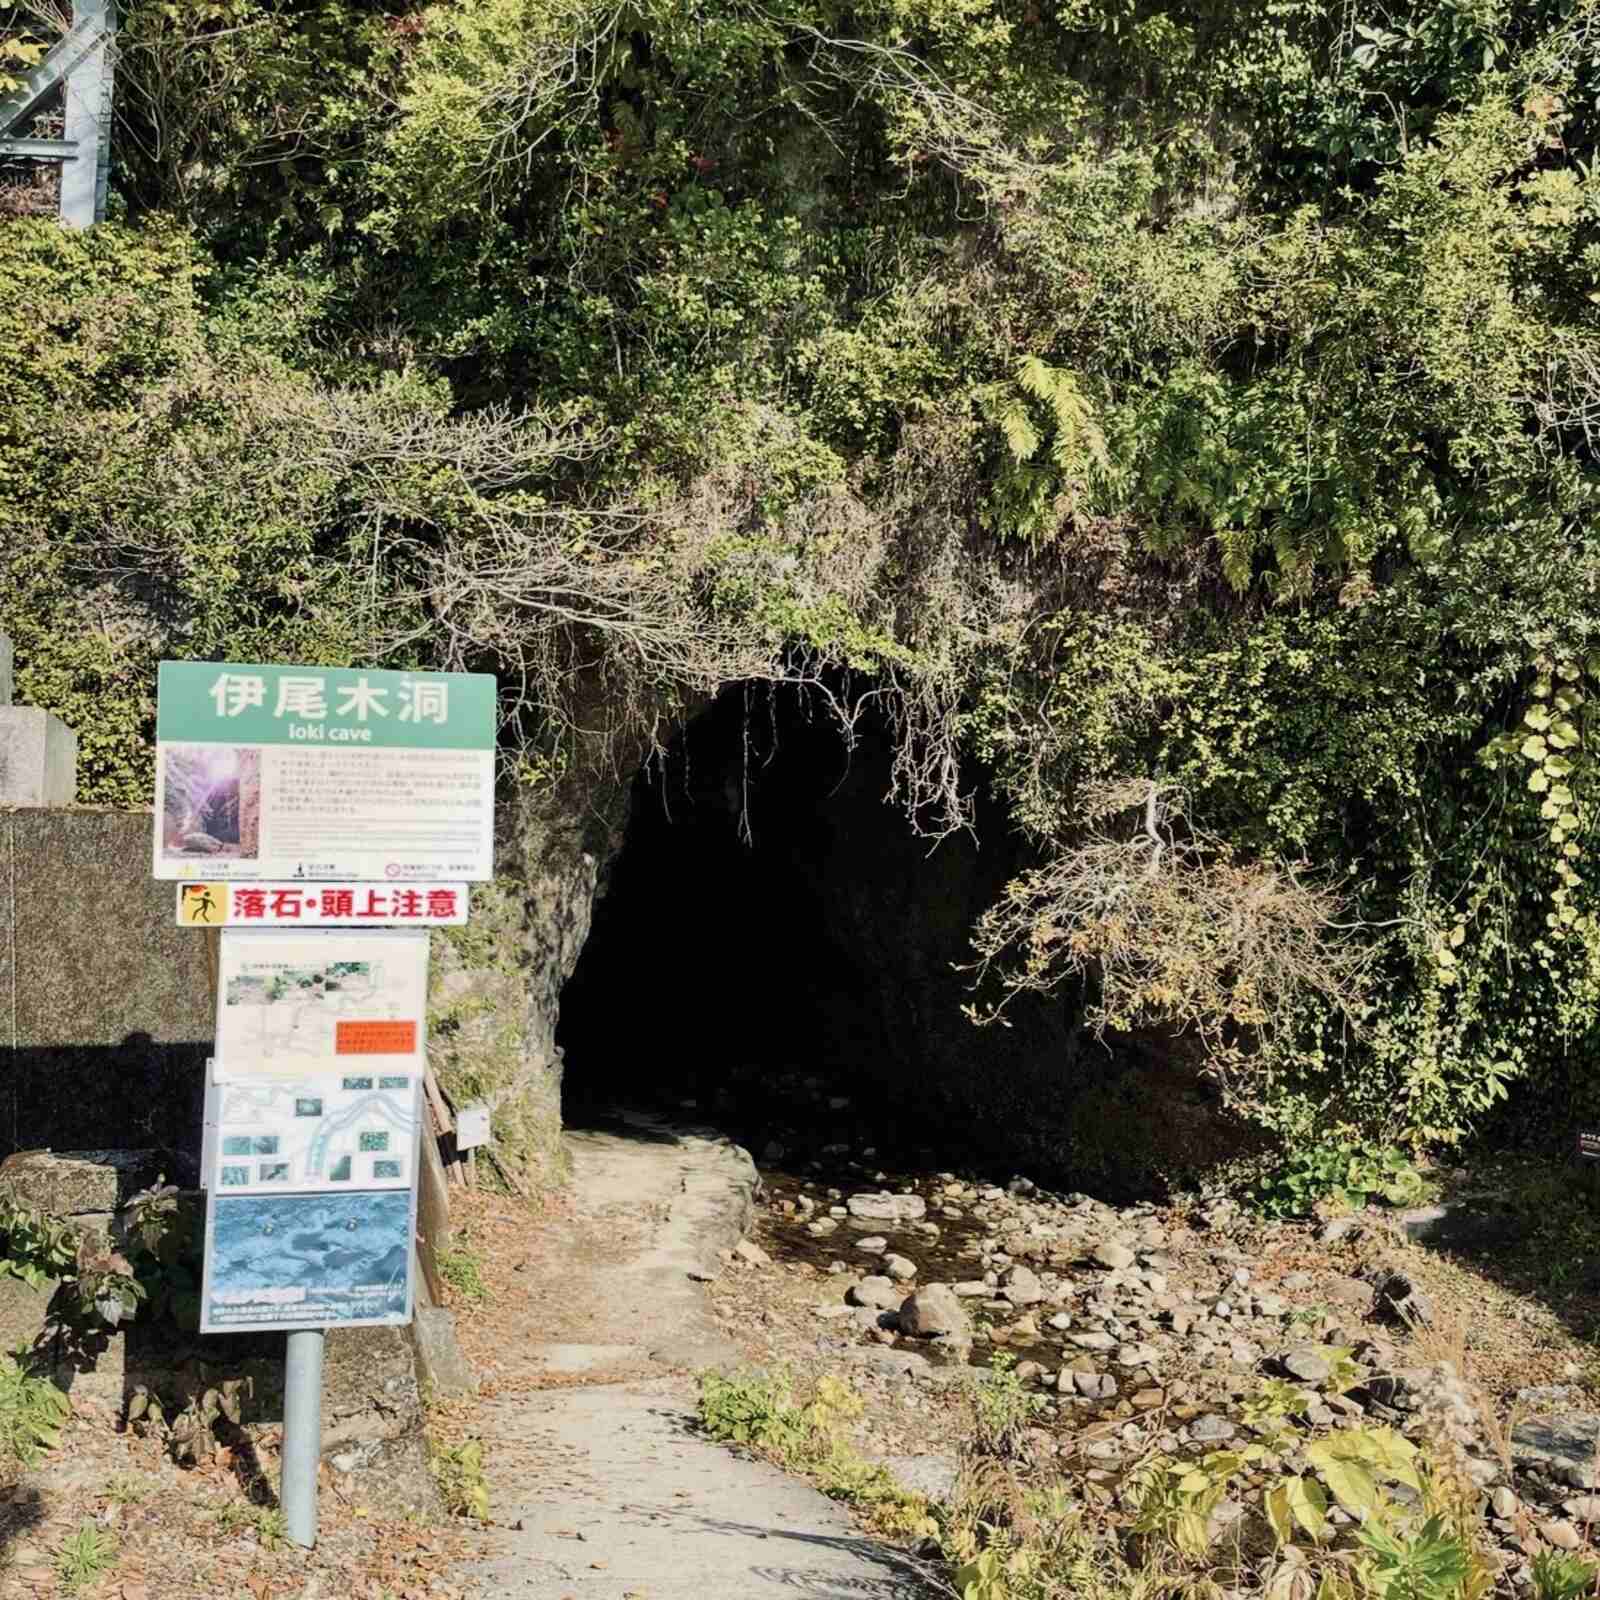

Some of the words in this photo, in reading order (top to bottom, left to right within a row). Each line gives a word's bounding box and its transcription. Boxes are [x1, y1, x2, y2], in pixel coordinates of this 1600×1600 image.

[209, 673, 449, 724] 伊尾木洞
[328, 728, 372, 741] cave
[233, 889, 456, 918] 落石・頭上注意
